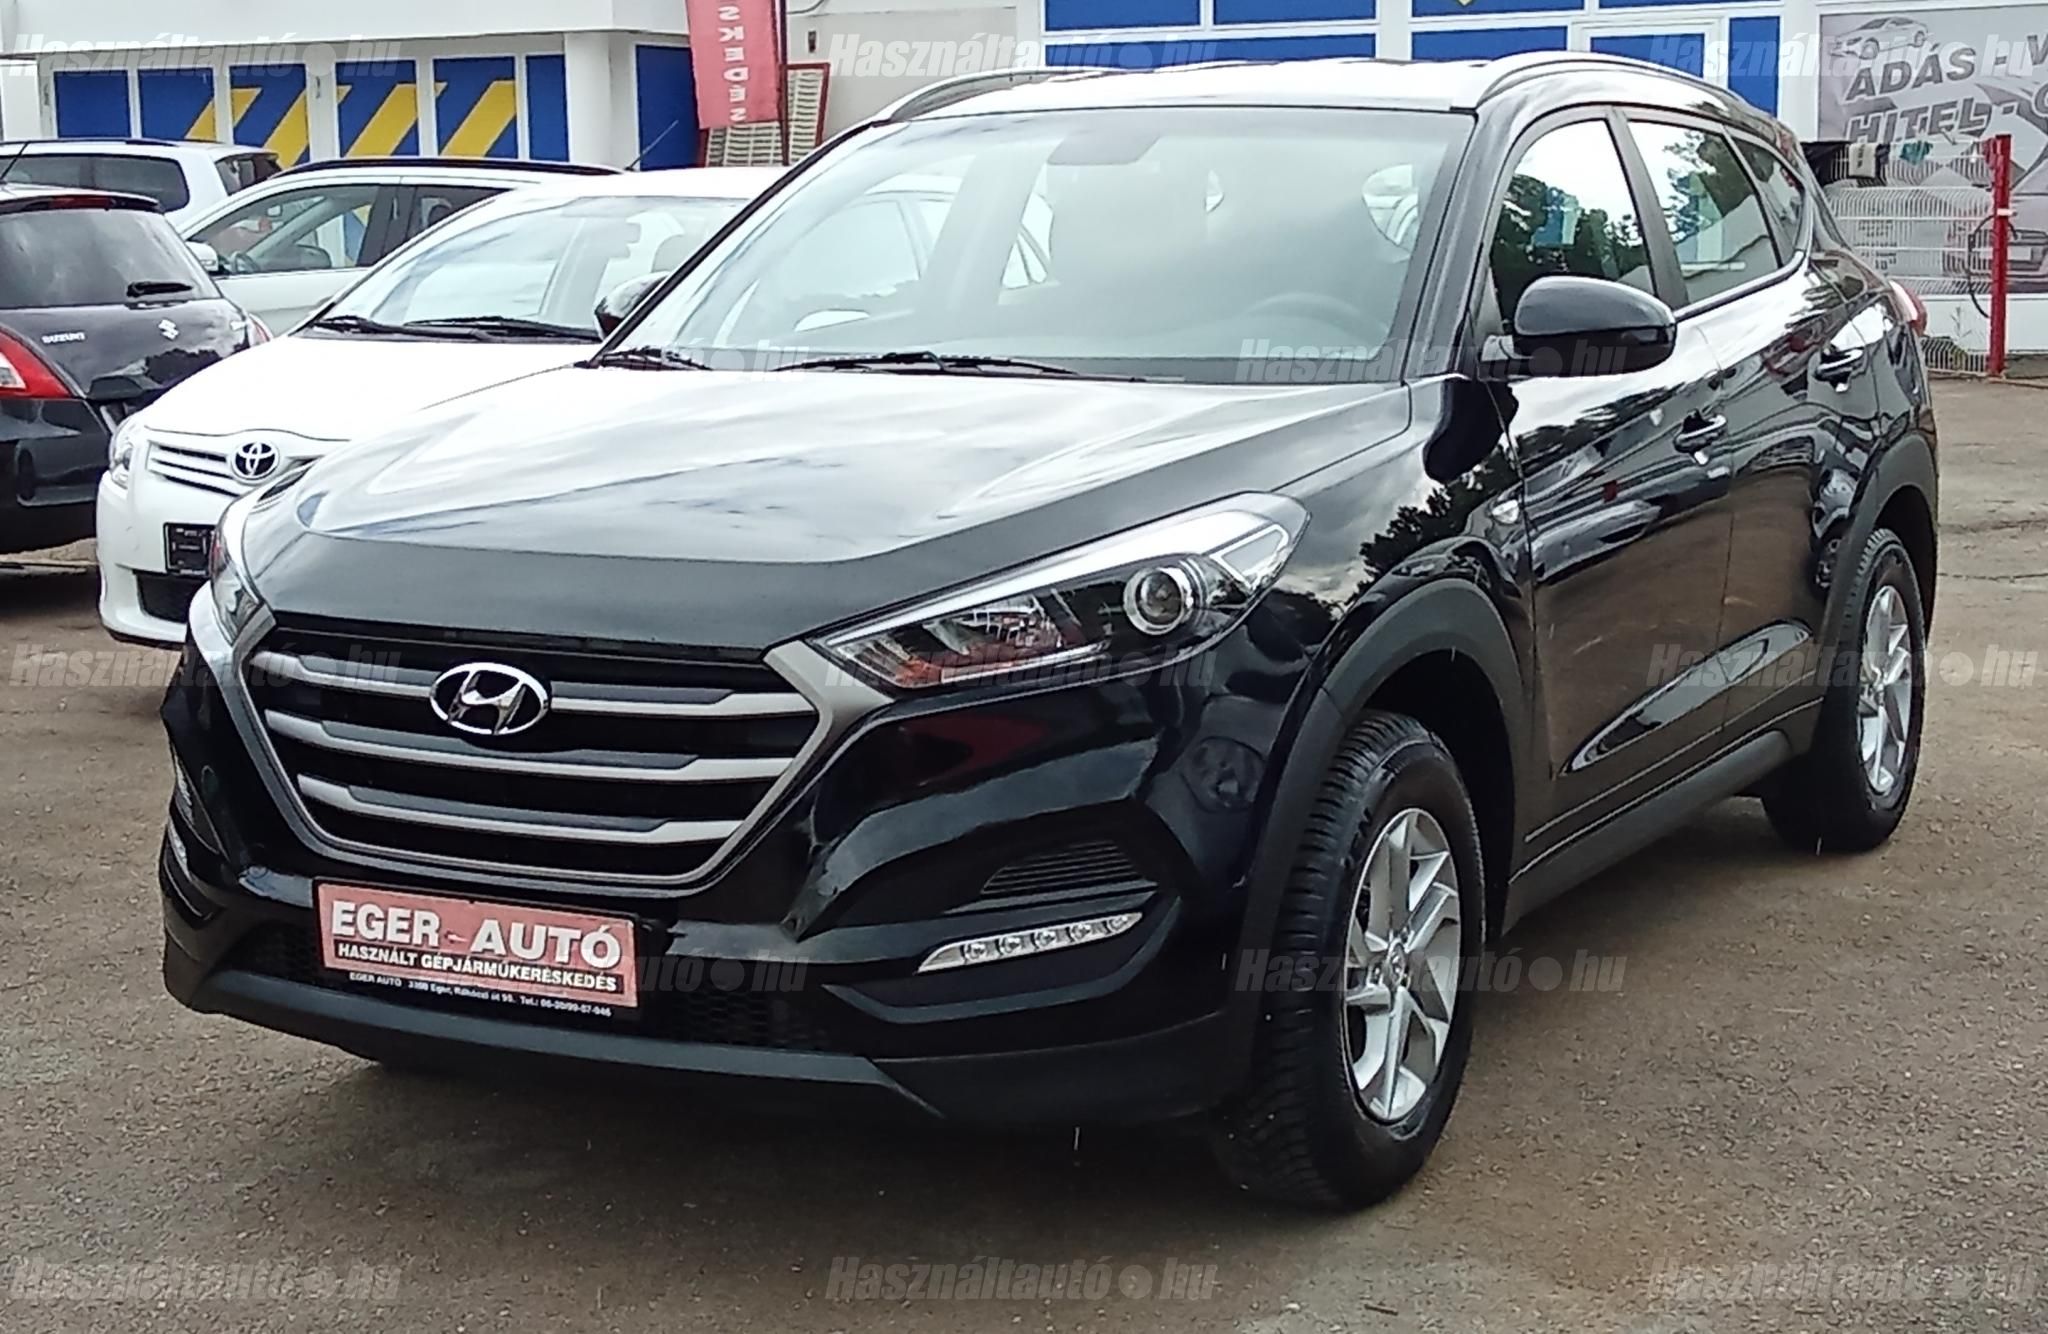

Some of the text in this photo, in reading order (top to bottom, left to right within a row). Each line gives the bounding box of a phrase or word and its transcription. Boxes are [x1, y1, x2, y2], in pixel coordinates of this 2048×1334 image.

[1847, 98, 1986, 145] HITEL
[332, 900, 440, 947] EGER
[470, 919, 621, 969] AUTÓ
[338, 943, 418, 966] HASZNÁLT
[349, 972, 375, 983] EGER
